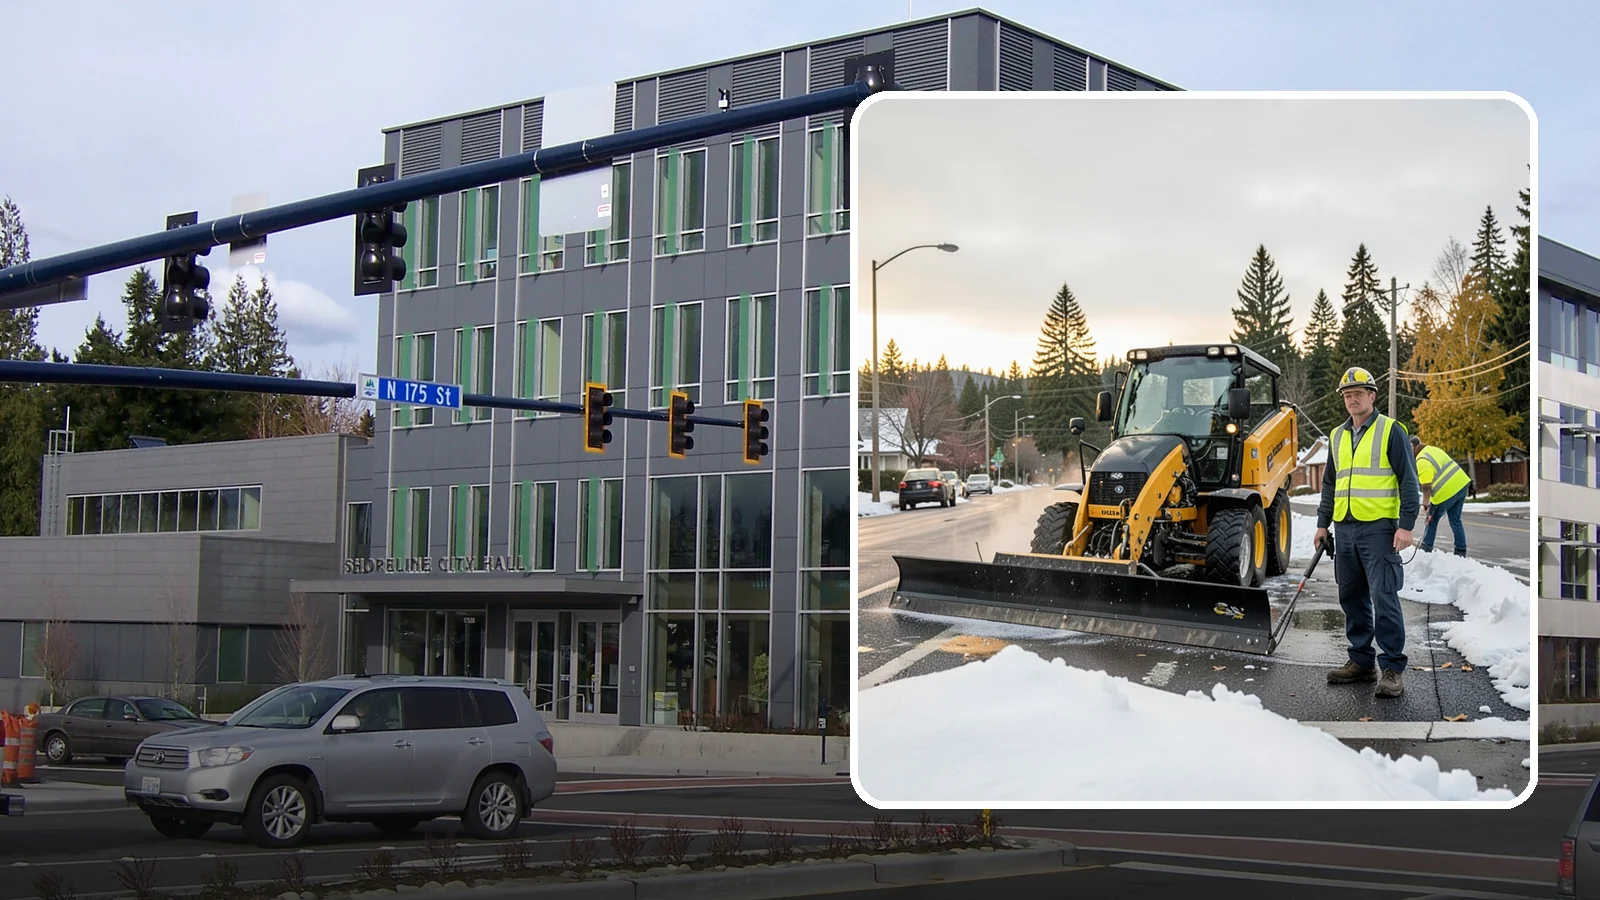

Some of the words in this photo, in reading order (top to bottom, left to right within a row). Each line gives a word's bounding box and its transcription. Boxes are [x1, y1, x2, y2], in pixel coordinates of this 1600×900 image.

[387, 381, 396, 400] N
[405, 383, 428, 402] 175
[436, 387, 452, 406] St
[344, 557, 432, 574] SHORELINE
[438, 556, 476, 572] CITY
[484, 555, 526, 571] HALL
